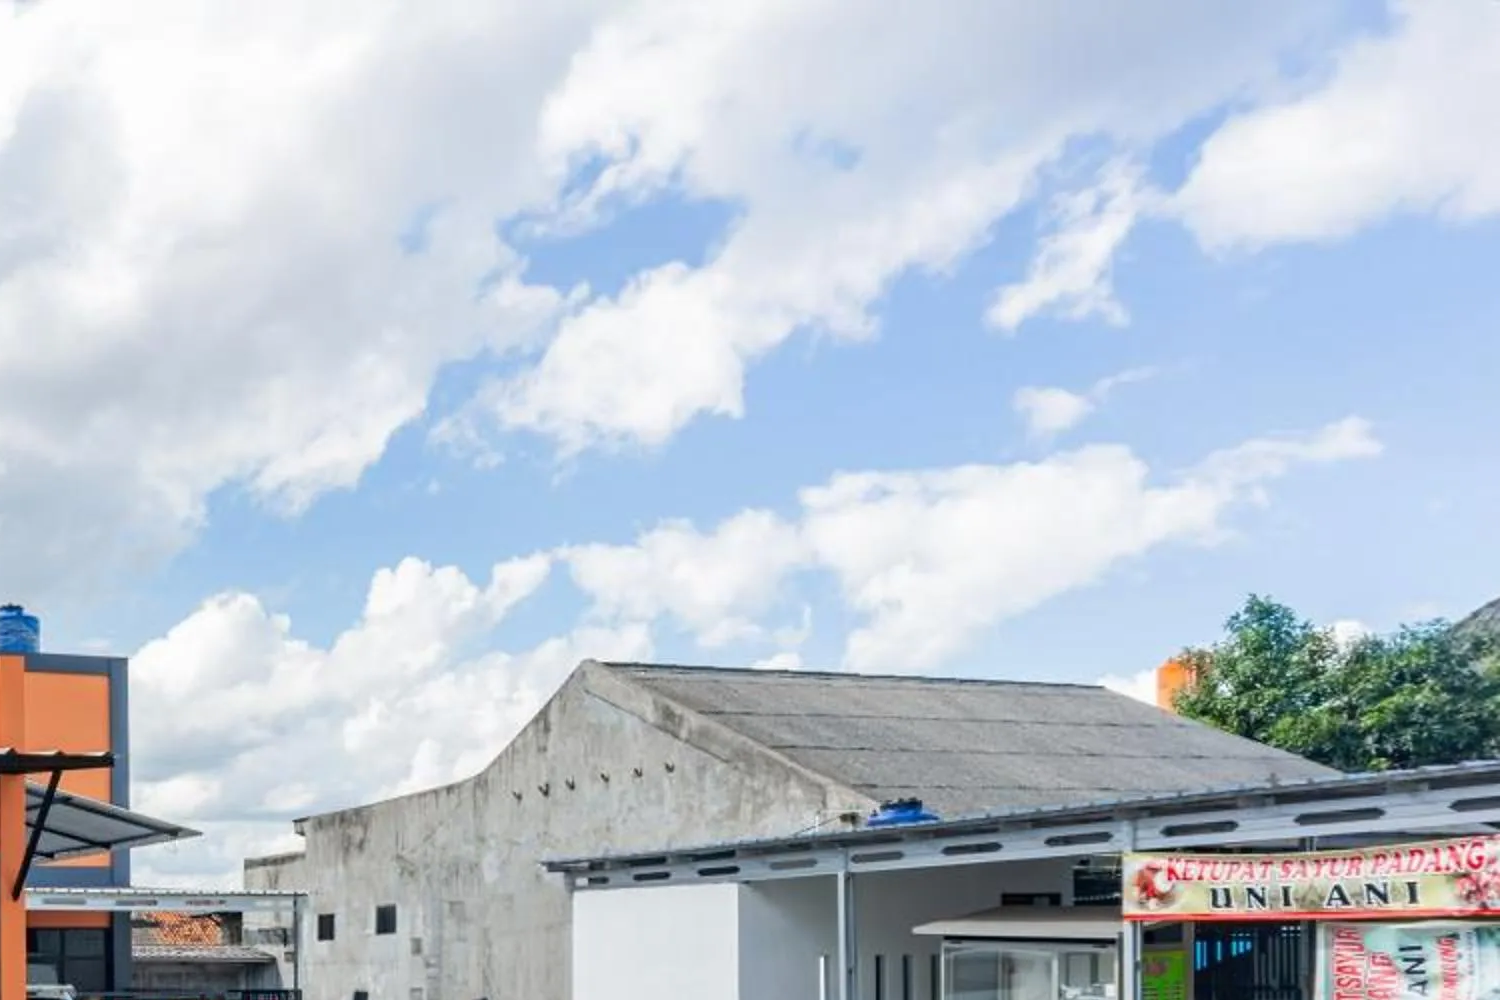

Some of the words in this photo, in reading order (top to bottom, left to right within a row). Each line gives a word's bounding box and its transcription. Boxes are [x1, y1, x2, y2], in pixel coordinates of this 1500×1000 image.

[1167, 857, 1274, 881] KETUPAT
[1279, 855, 1363, 878] SAYUR
[1371, 840, 1485, 874] PADANG
[1210, 885, 1293, 909] UNI
[1326, 881, 1419, 908] ANI
[1399, 945, 1429, 996] ANI
